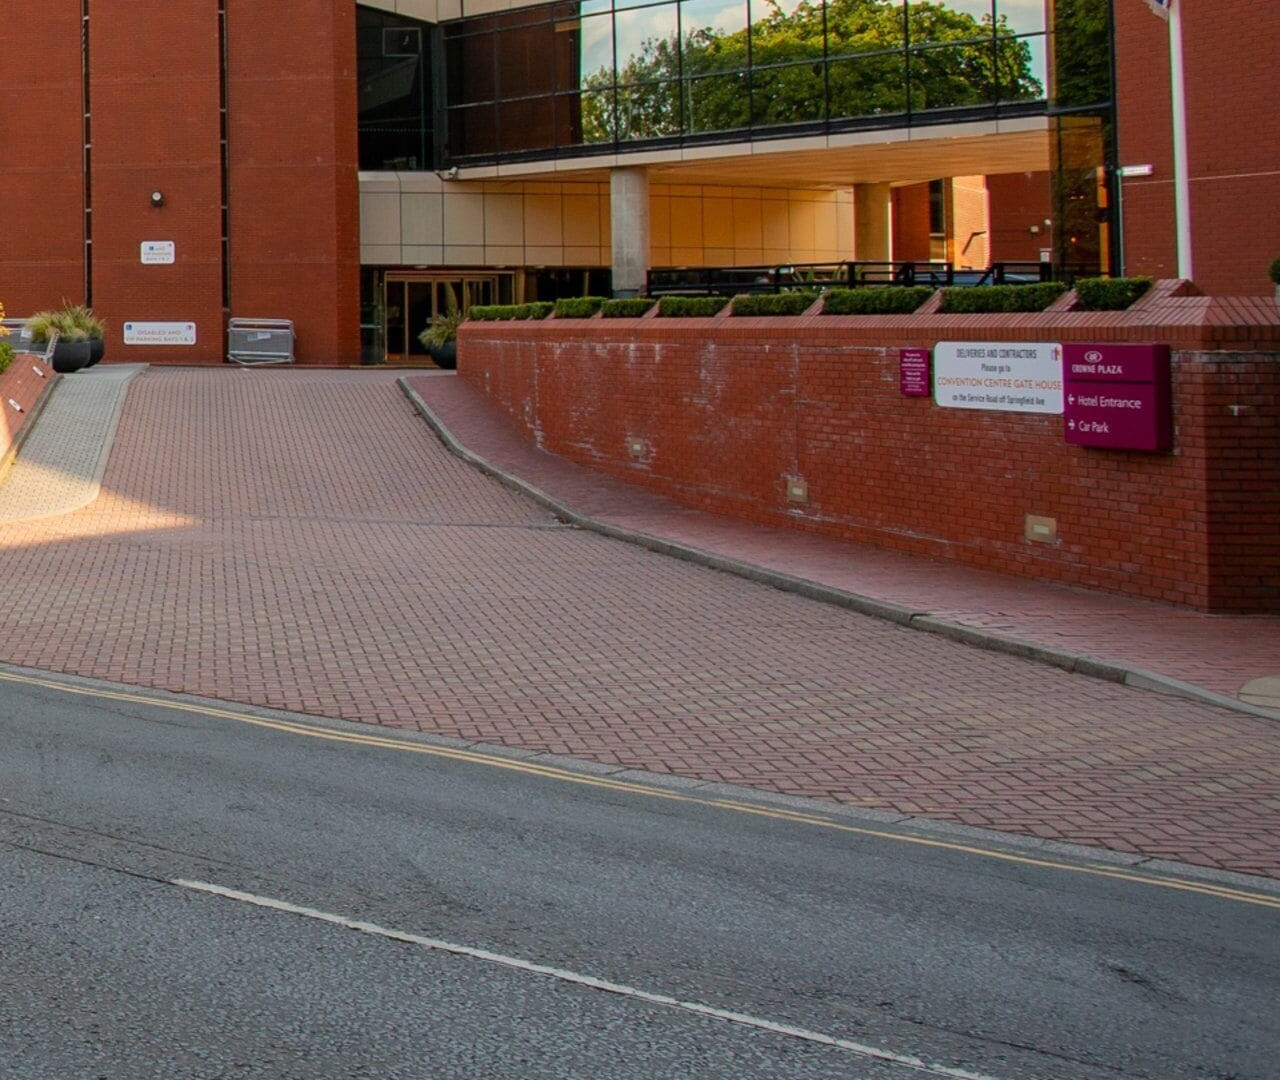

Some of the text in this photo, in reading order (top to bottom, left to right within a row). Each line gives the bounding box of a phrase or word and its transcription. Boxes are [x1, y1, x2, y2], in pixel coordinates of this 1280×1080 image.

[956, 348, 1037, 359] DELIVERIES AND CONTRACTORS
[981, 363, 997, 372] Please
[998, 365, 1005, 373] go
[1072, 364, 1123, 374] CROWNE PLAZA
[937, 376, 1062, 390] CONVENTION CENTRE GATE HOUSE
[967, 394, 985, 402] Service
[986, 395, 998, 403] Road
[1007, 395, 1034, 406] Springfield
[1078, 395, 1142, 409] Hotel Entrance
[1078, 420, 1110, 433] Car Park
